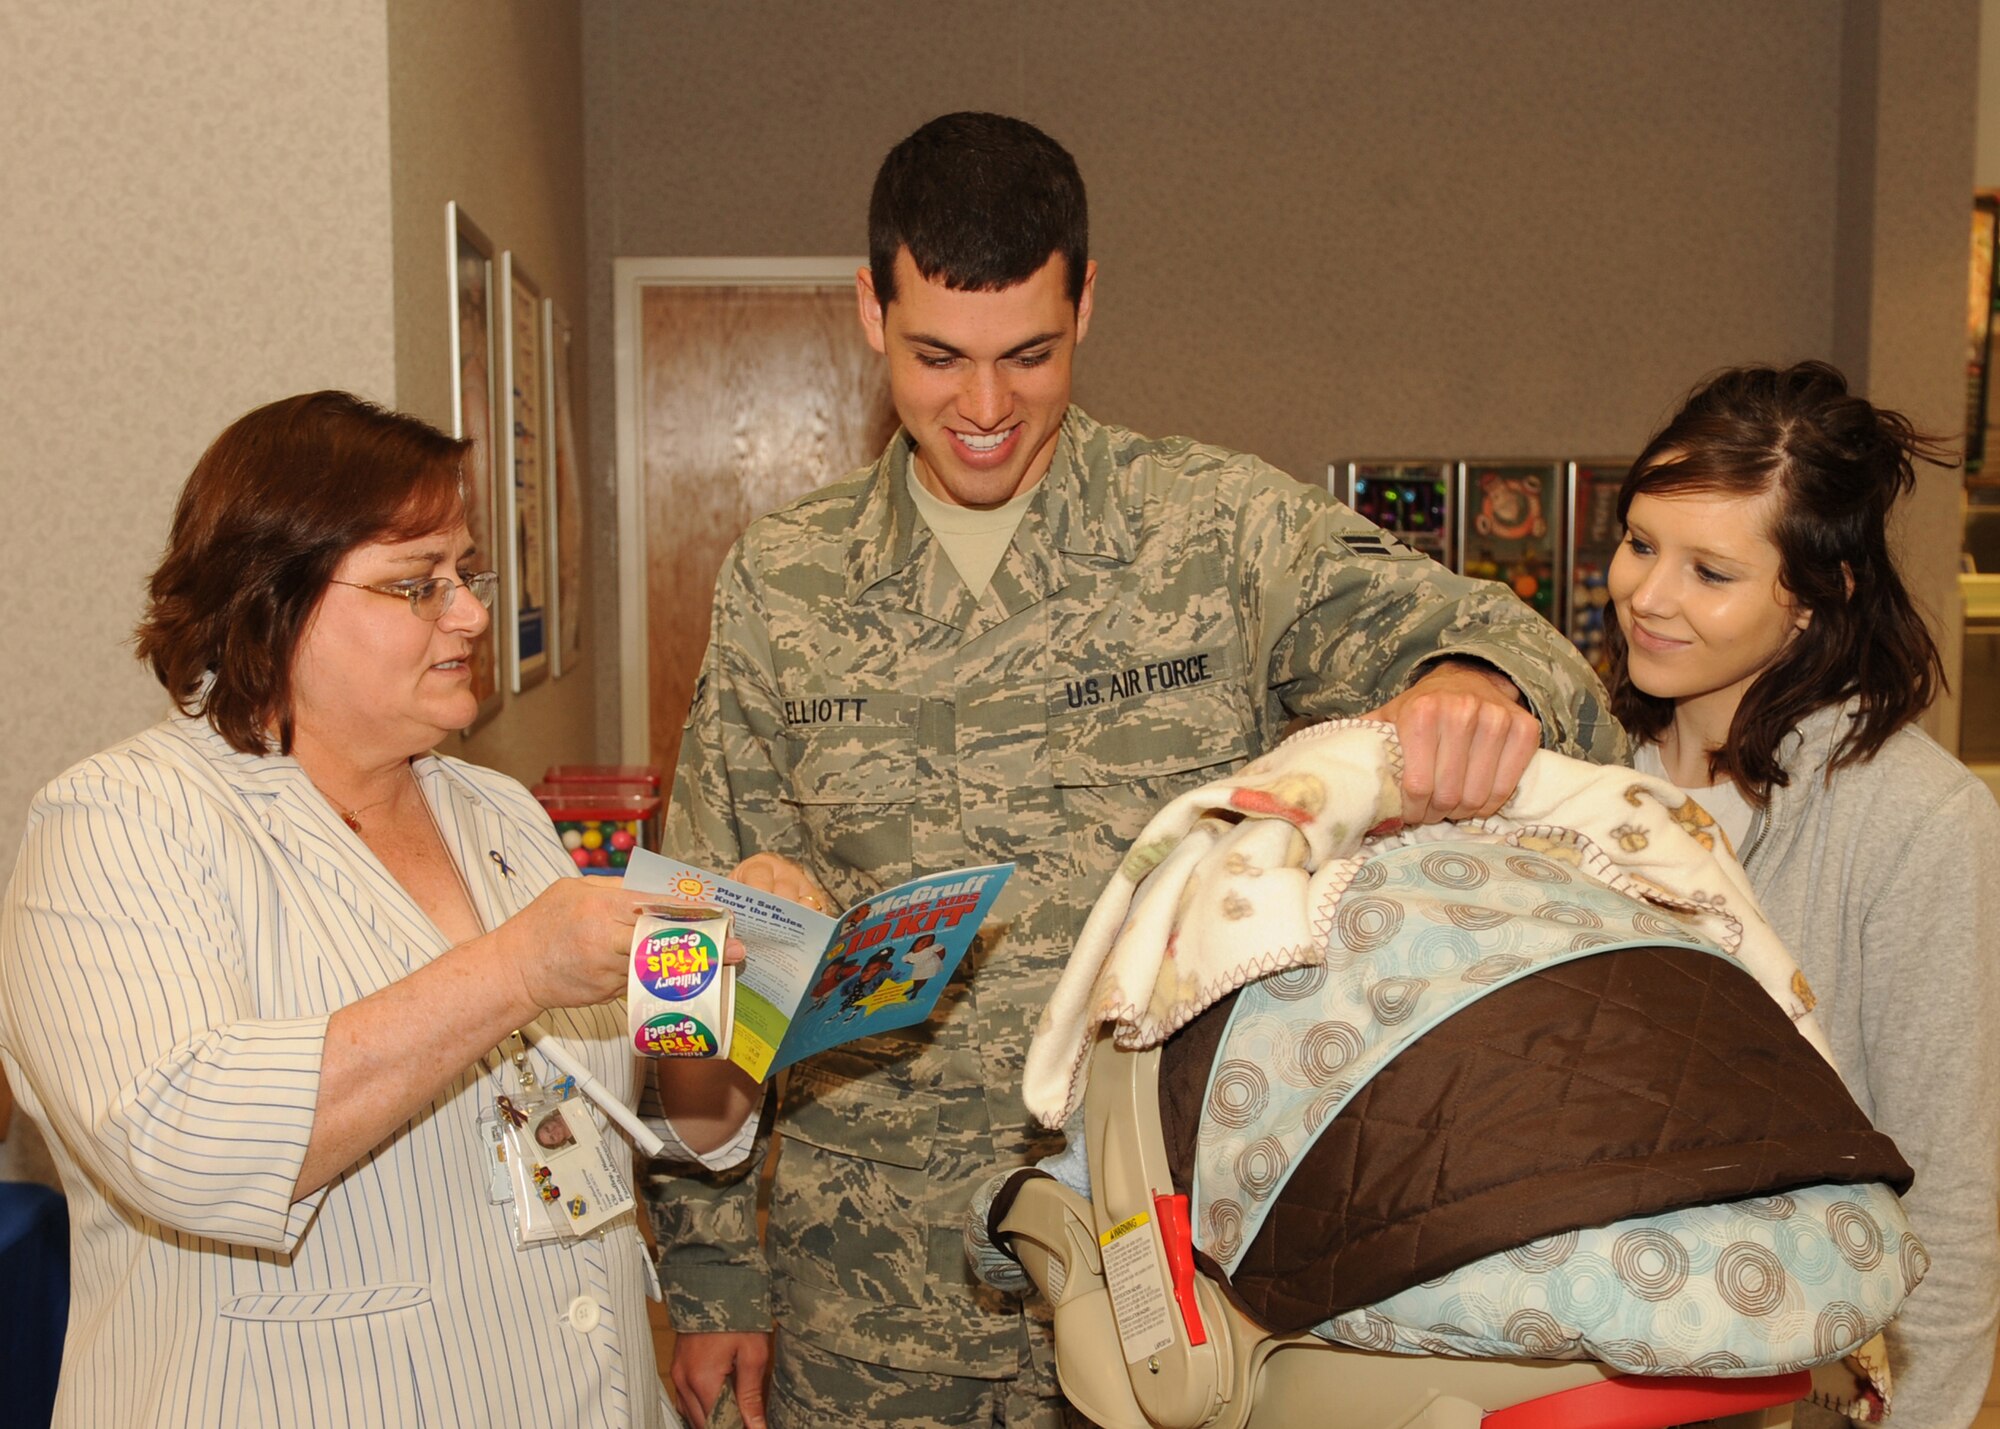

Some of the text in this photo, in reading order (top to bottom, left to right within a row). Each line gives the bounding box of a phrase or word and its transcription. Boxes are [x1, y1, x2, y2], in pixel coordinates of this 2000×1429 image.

[1066, 654, 1212, 709] U.S. AIR FORCE
[785, 698, 868, 725] ELLIOTT
[714, 894, 805, 930] Know the Rules.
[717, 886, 742, 900] Play
[757, 900, 785, 914] Safe.
[866, 874, 990, 920] McGruff
[884, 892, 981, 921] SAFE KIDS
[891, 902, 977, 939] KIT
[646, 946, 709, 978] Kids
[654, 972, 701, 990] Military
[647, 1034, 709, 1054] Kids
